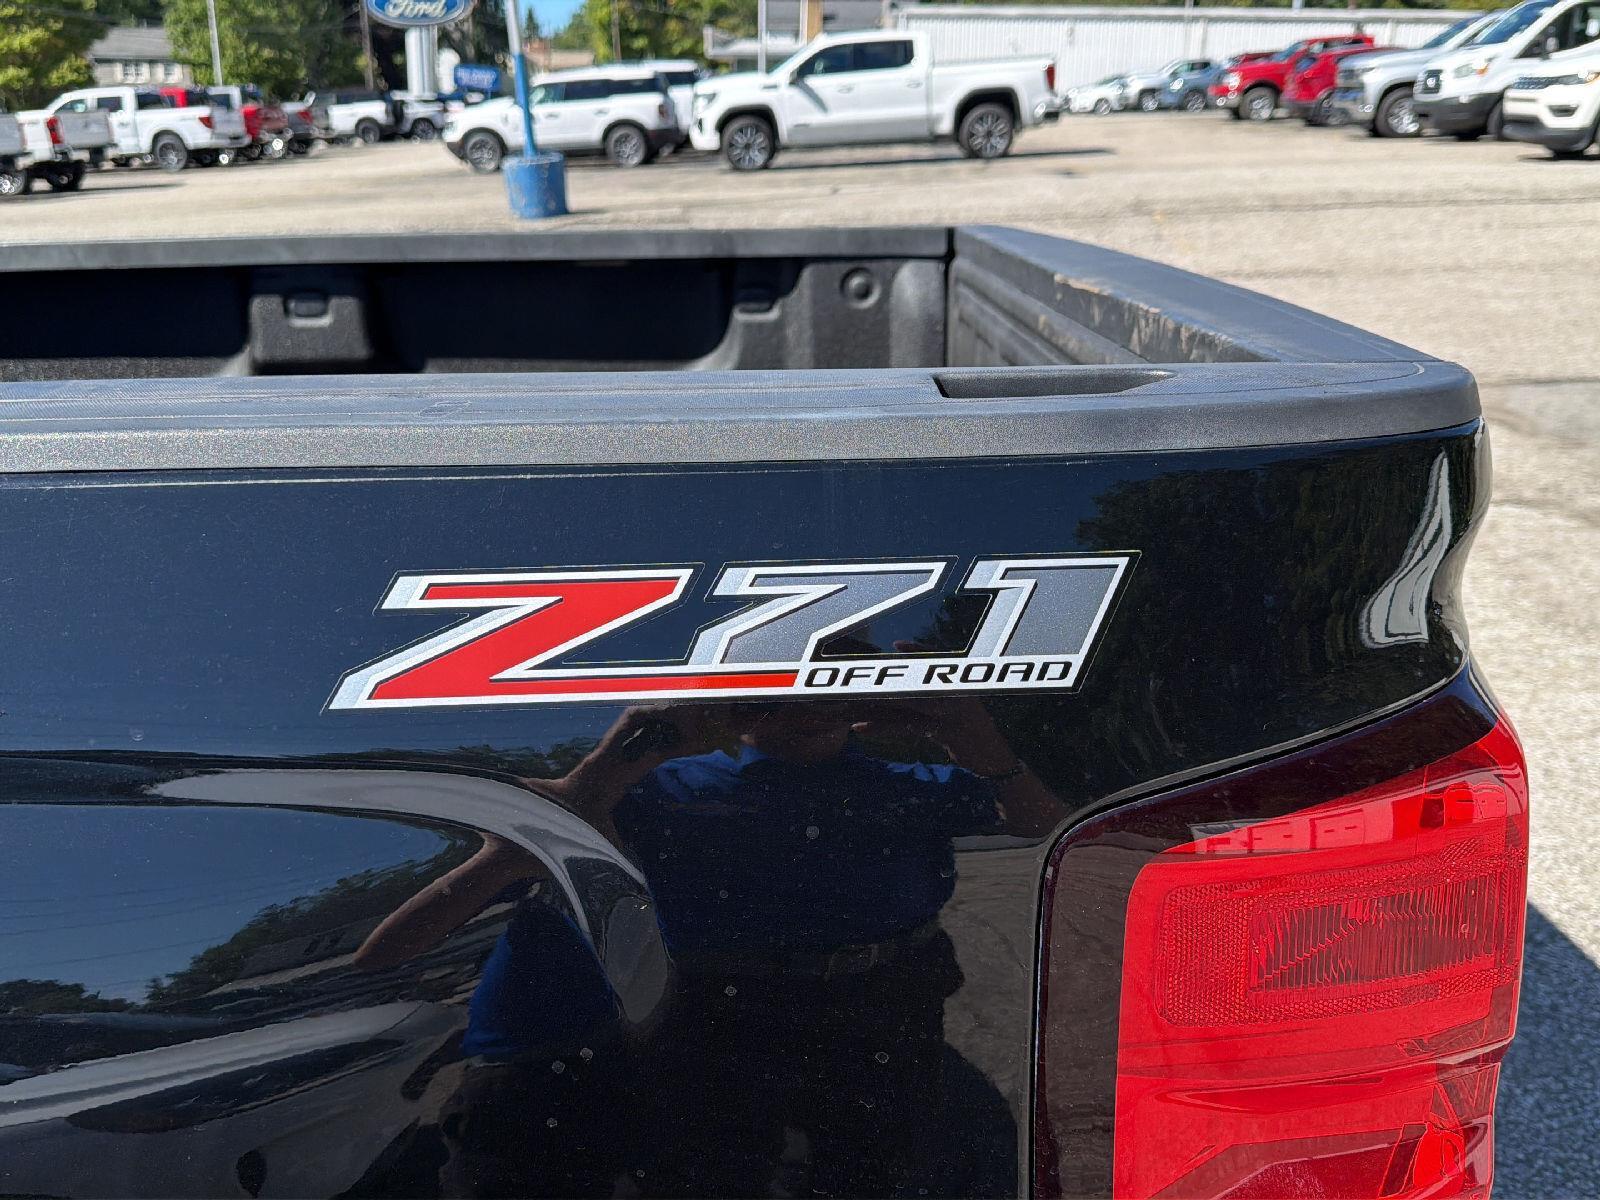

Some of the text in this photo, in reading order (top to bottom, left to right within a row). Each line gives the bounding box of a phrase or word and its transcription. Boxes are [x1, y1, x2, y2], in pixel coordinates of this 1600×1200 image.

[384, 0, 449, 18] Ford
[328, 556, 1130, 710] Z71
[804, 661, 1073, 688] OFF ROAD
